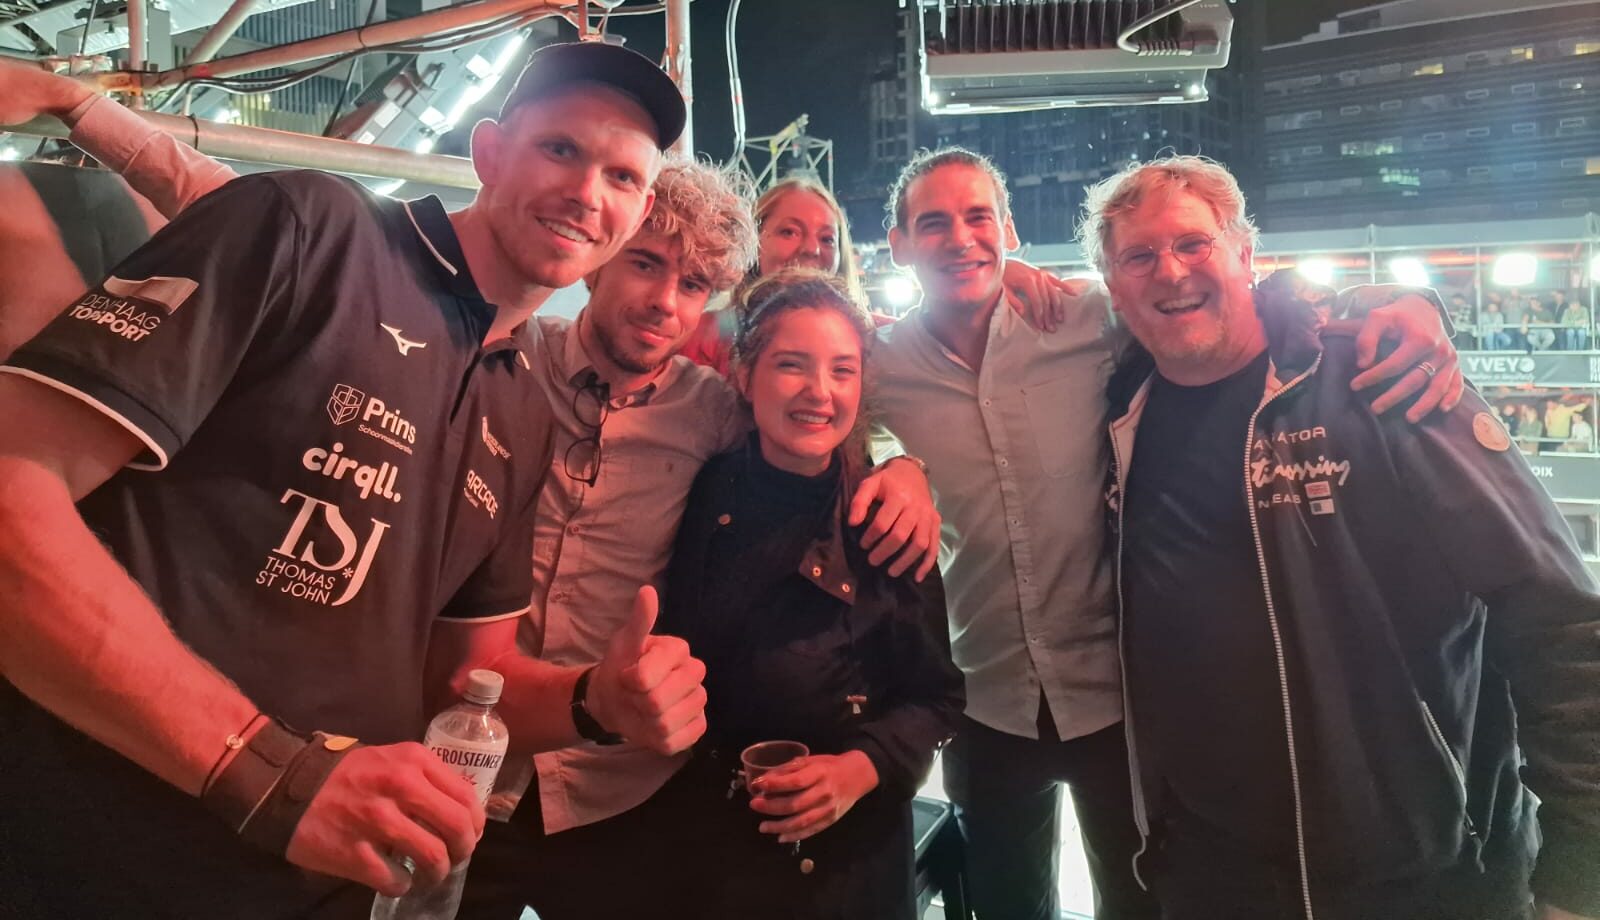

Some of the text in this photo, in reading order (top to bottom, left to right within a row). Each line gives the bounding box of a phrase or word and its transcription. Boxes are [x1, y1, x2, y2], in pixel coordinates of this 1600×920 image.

[80, 294, 161, 330] DEN HAAG
[362, 396, 417, 445] Prins
[302, 442, 402, 503] cirqll.
[466, 469, 499, 520] ARCADE
[272, 488, 391, 607] TSJ
[255, 571, 331, 605] ST JOHN
[265, 556, 336, 590] THOMAS
[431, 746, 503, 769] EROLSTEINER
